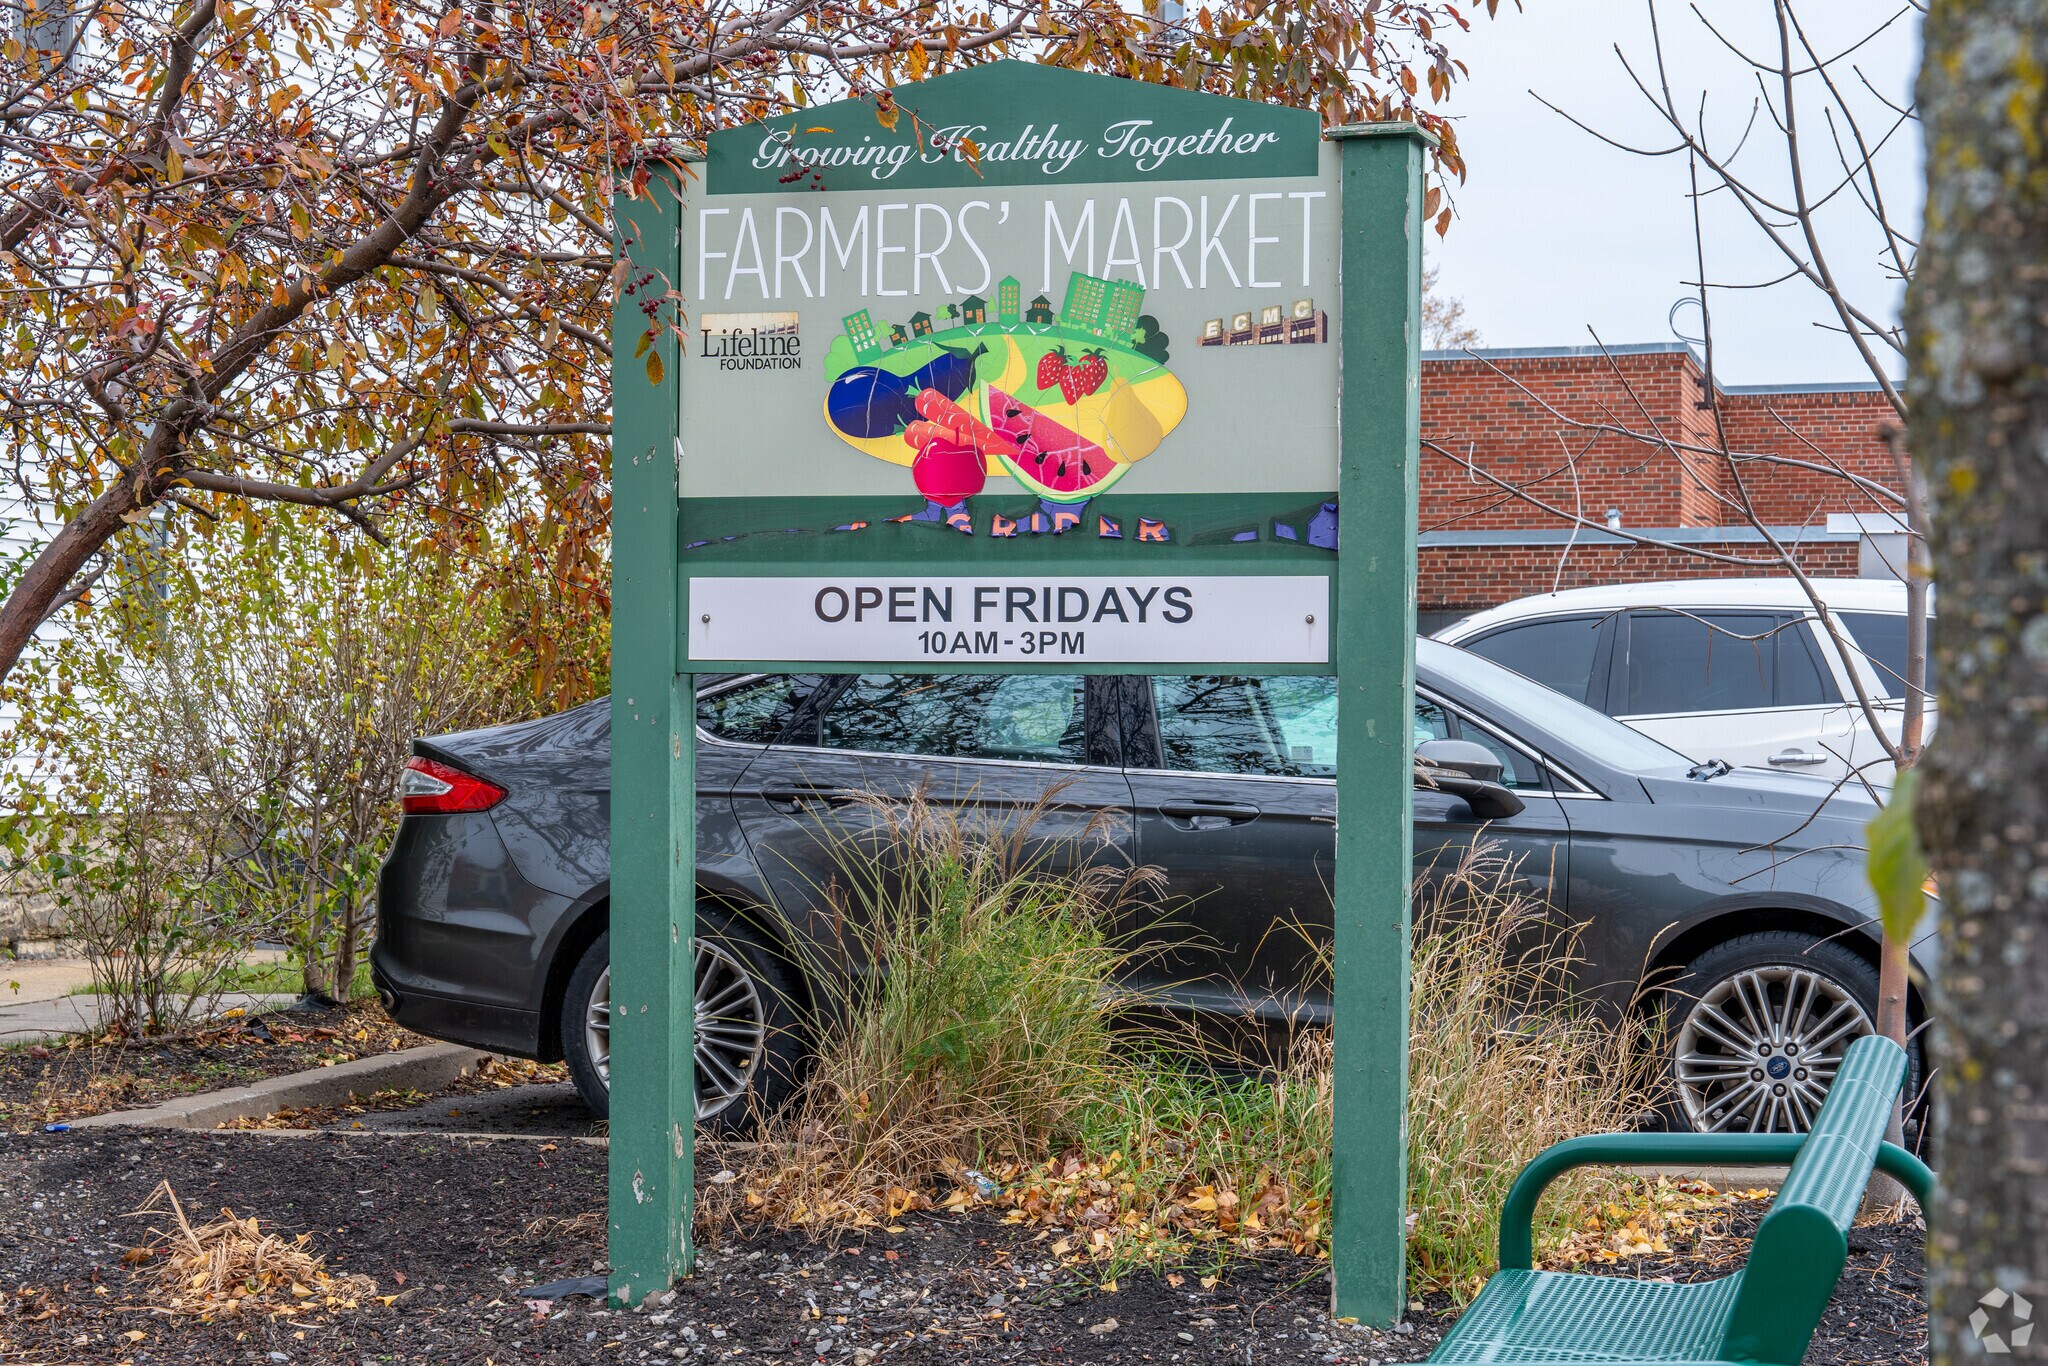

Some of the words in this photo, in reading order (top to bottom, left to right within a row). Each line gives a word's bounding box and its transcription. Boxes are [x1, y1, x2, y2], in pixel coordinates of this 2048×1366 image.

[752, 127, 917, 180] Growing
[921, 123, 1088, 174] Healthy
[1098, 117, 1280, 172] Together
[1044, 191, 1326, 293] MARKET
[701, 328, 800, 357] Lifeline
[721, 358, 801, 370] FOUNDATION
[814, 587, 953, 623] OPEN
[973, 586, 1194, 624] FRIDAYS
